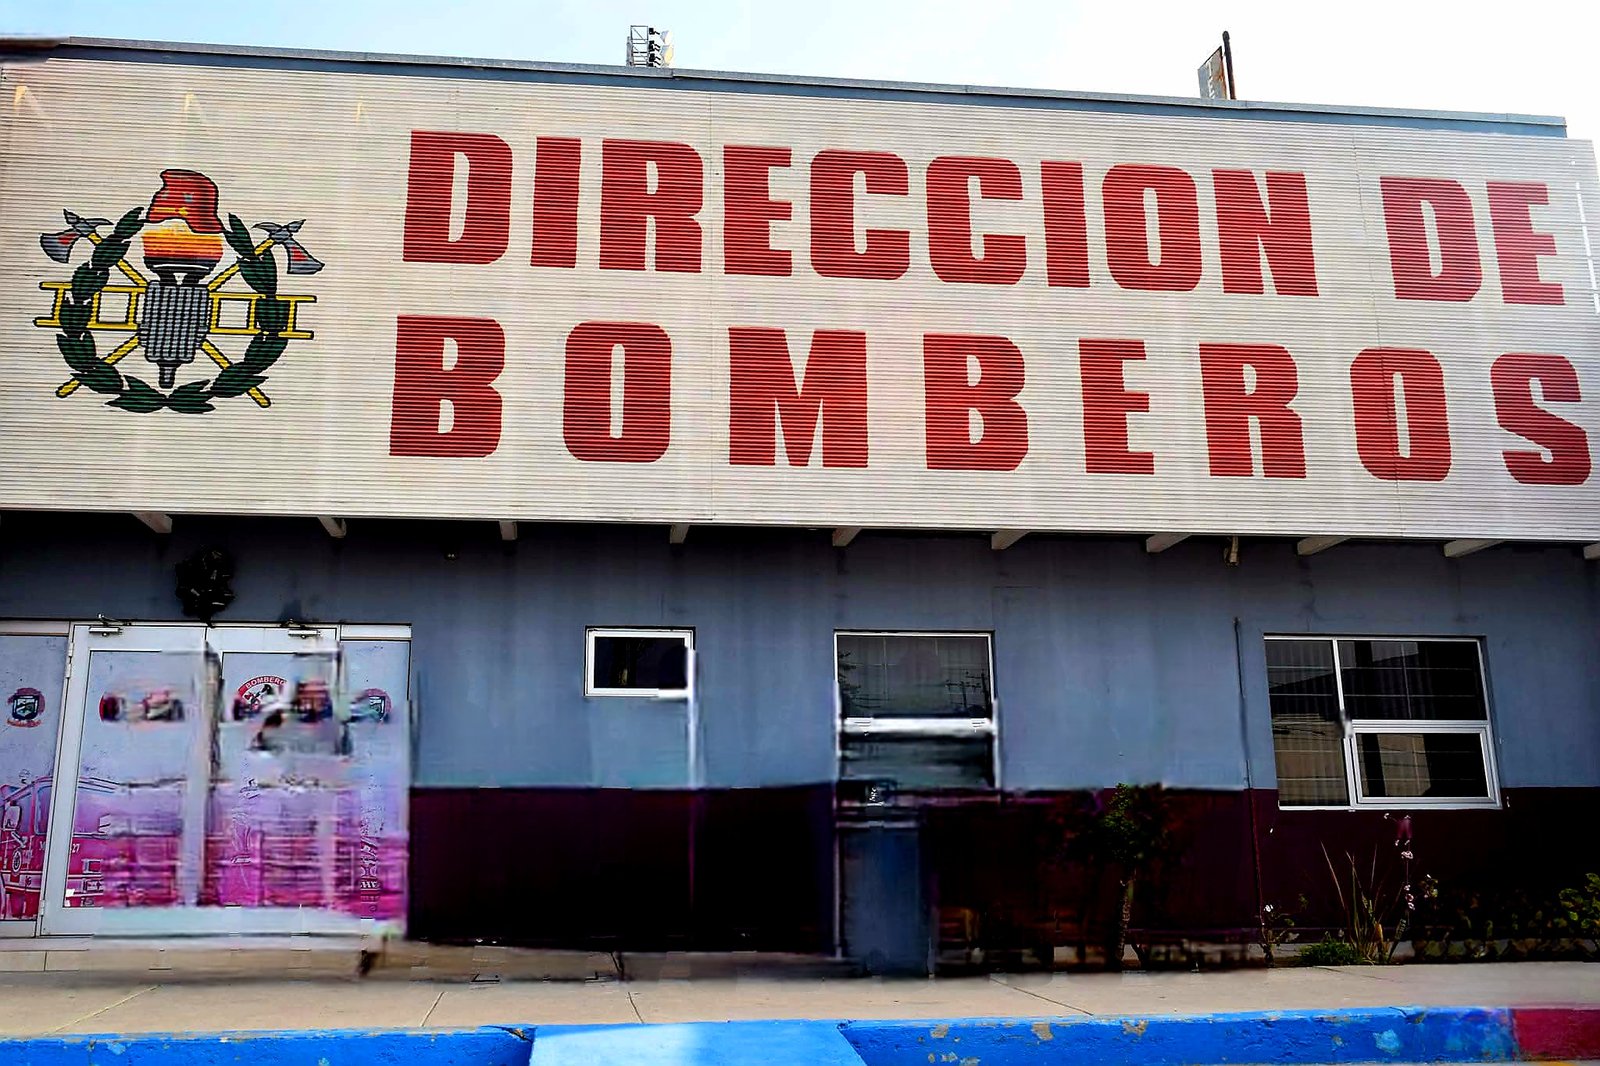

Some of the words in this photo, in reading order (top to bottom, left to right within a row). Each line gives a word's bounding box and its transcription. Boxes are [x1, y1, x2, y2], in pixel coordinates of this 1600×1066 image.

[403, 129, 1319, 297] DIRECCION
[1380, 176, 1566, 305] DE
[389, 315, 1592, 486] BOMBEROS
